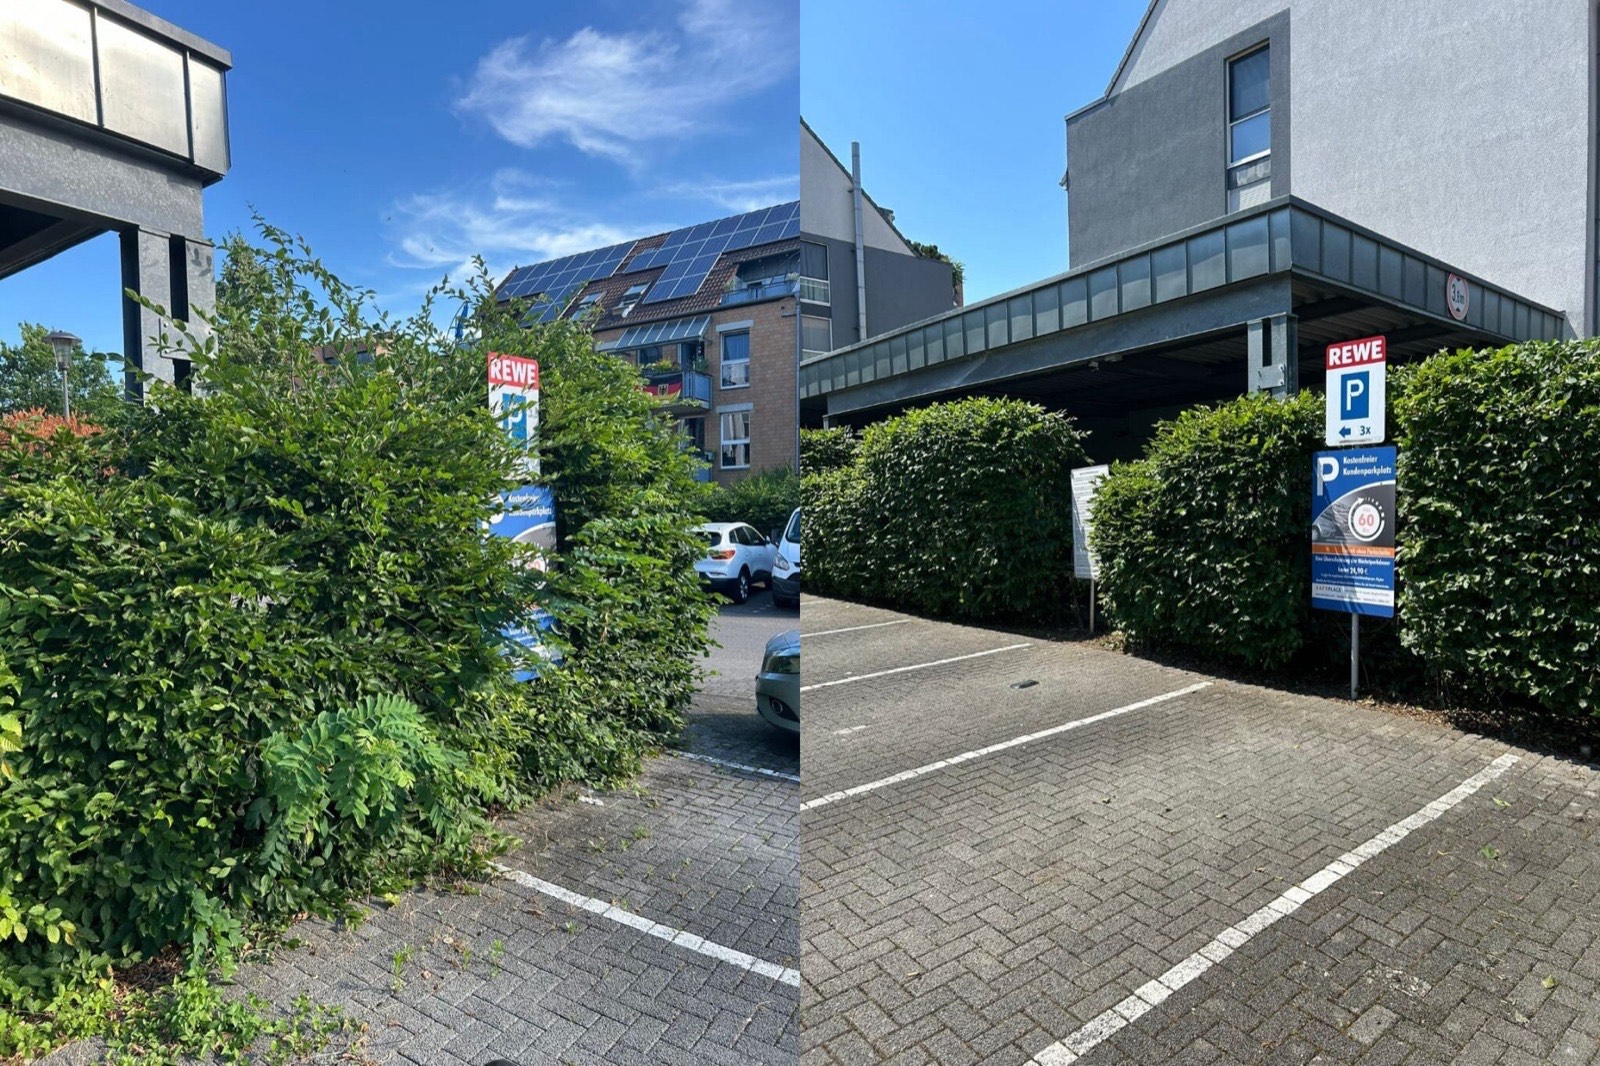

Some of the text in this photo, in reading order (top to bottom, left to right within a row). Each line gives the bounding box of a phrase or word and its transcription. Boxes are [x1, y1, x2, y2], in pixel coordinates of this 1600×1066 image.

[1329, 340, 1383, 366] REWE
[490, 357, 536, 384] REWE
[1346, 379, 1364, 411] P
[1360, 425, 1371, 436] 3x
[1343, 455, 1378, 465] Kostenfreier
[1317, 456, 1340, 496] P
[1343, 465, 1392, 477] Kundenparkplatz
[1358, 514, 1374, 527] 60
